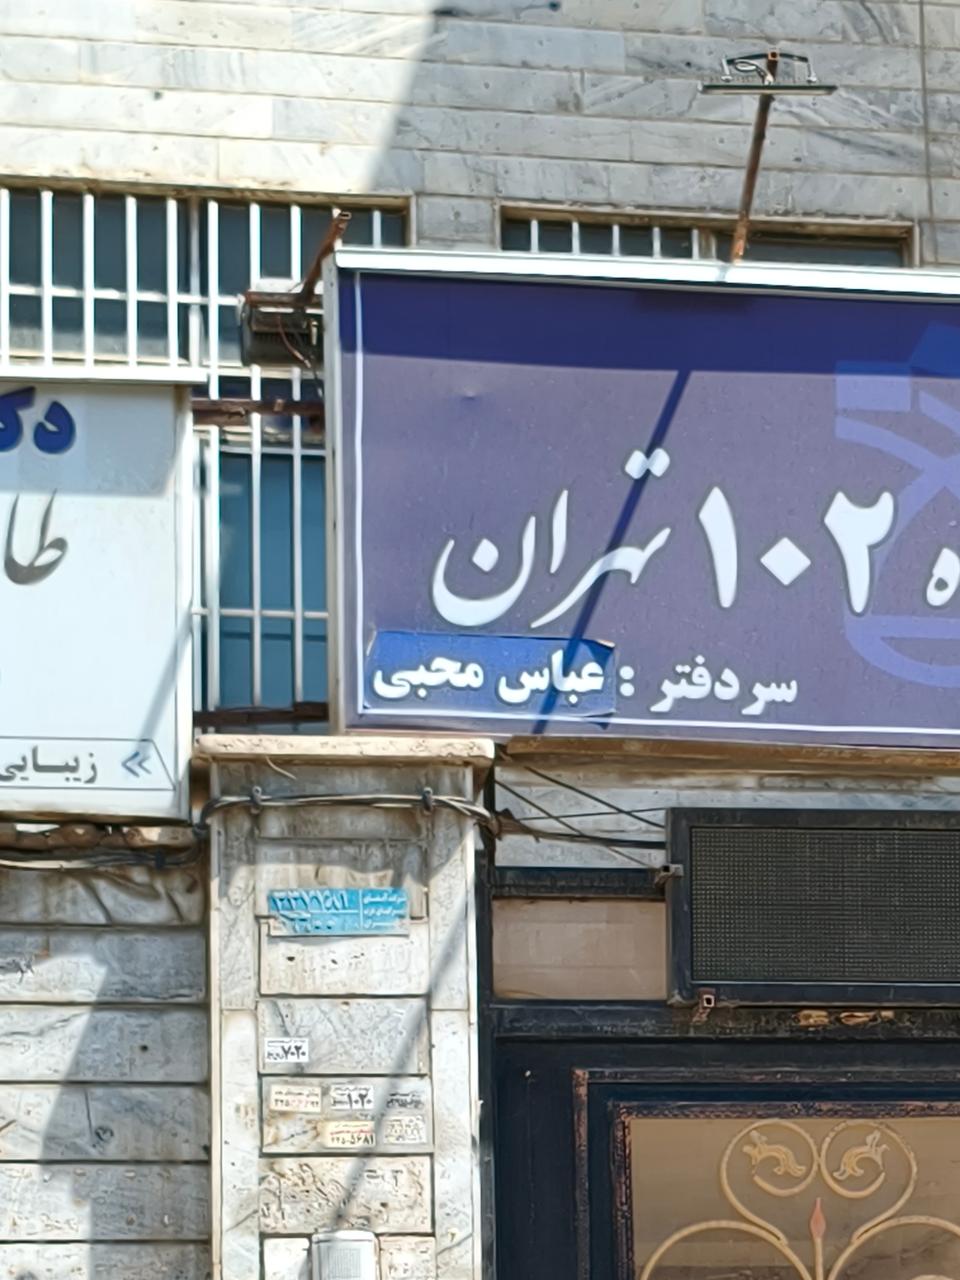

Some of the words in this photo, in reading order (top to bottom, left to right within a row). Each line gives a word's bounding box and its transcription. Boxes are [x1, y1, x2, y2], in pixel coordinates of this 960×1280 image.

[0, 386, 77, 454] دک
[432, 447, 671, 629] تهران
[698, 486, 895, 616] ۱۰۲
[372, 653, 485, 701] محبی
[498, 649, 606, 703] عباس
[649, 654, 799, 716] سردفتر
